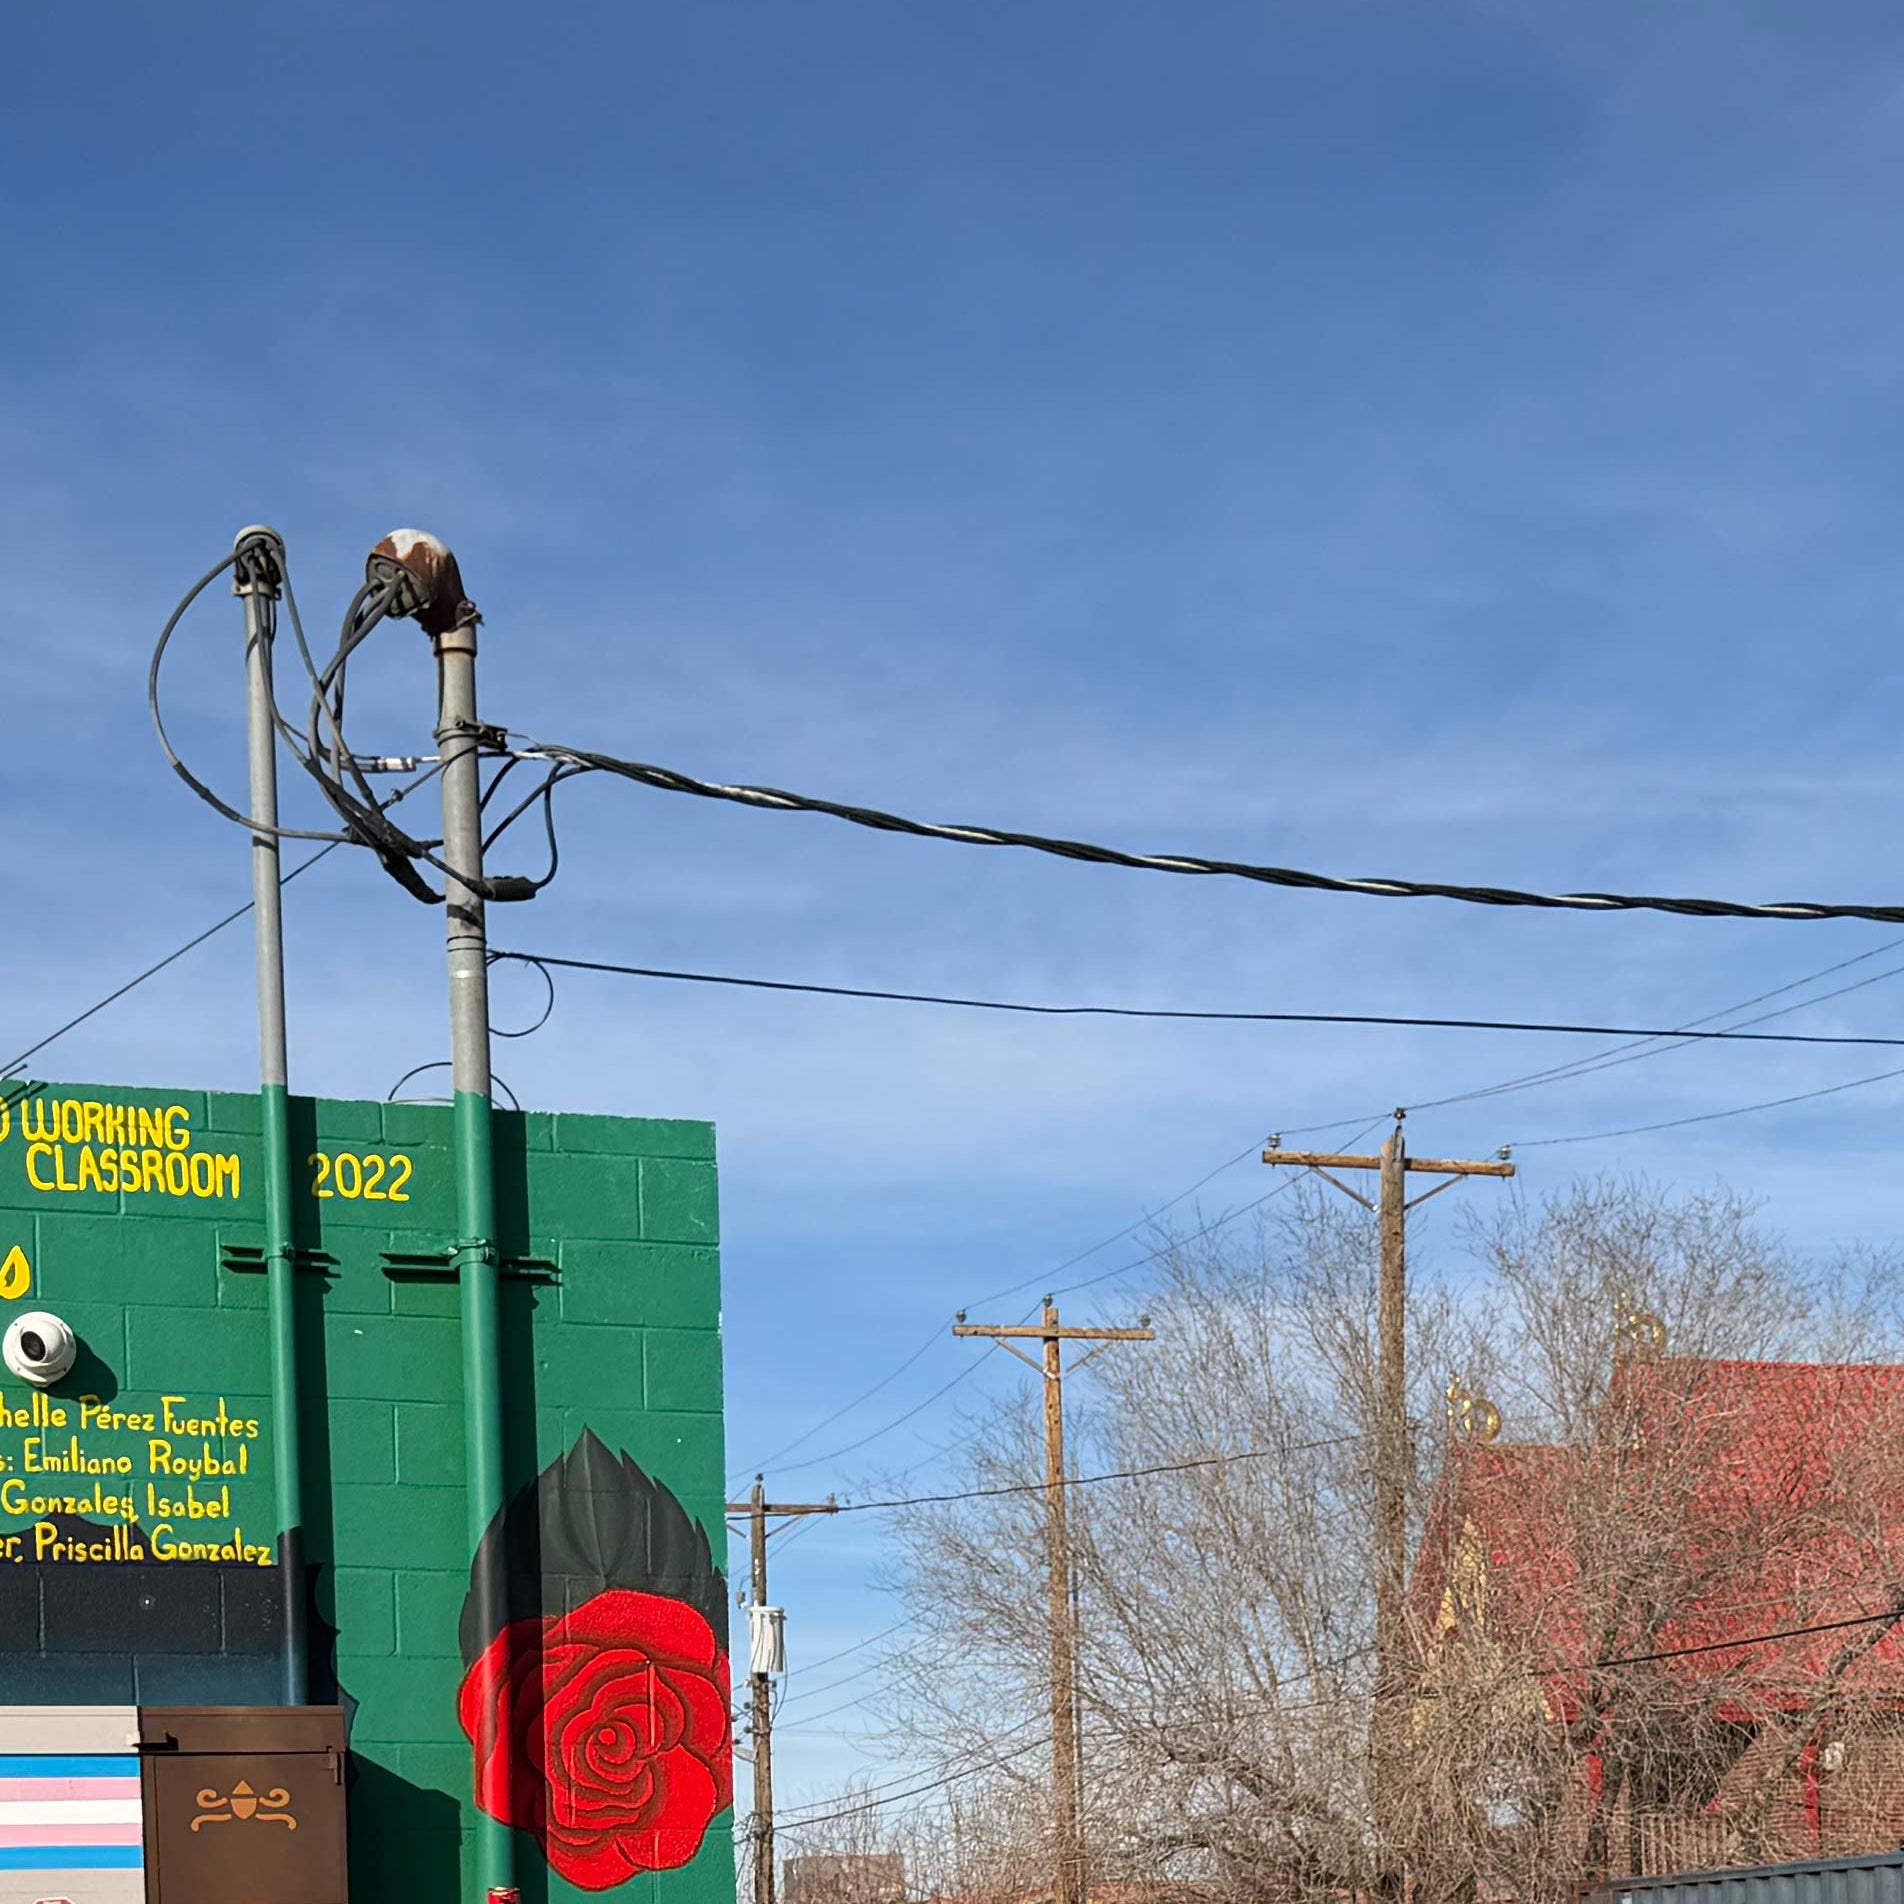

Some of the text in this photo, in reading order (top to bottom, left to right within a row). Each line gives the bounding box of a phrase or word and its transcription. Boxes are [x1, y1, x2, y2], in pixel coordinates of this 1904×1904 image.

[21, 1098, 191, 1151] WORKING
[25, 1142, 413, 1202] CLASSROOM 2022
[79, 1394, 156, 1431] Pérez
[160, 1395, 260, 1439] Fuentes
[23, 1437, 133, 1475] Emiliano
[148, 1439, 248, 1481] Roybal
[147, 1482, 230, 1519] Isabel
[35, 1525, 144, 1563] Priscilla
[150, 1527, 274, 1566] Gonzalez
